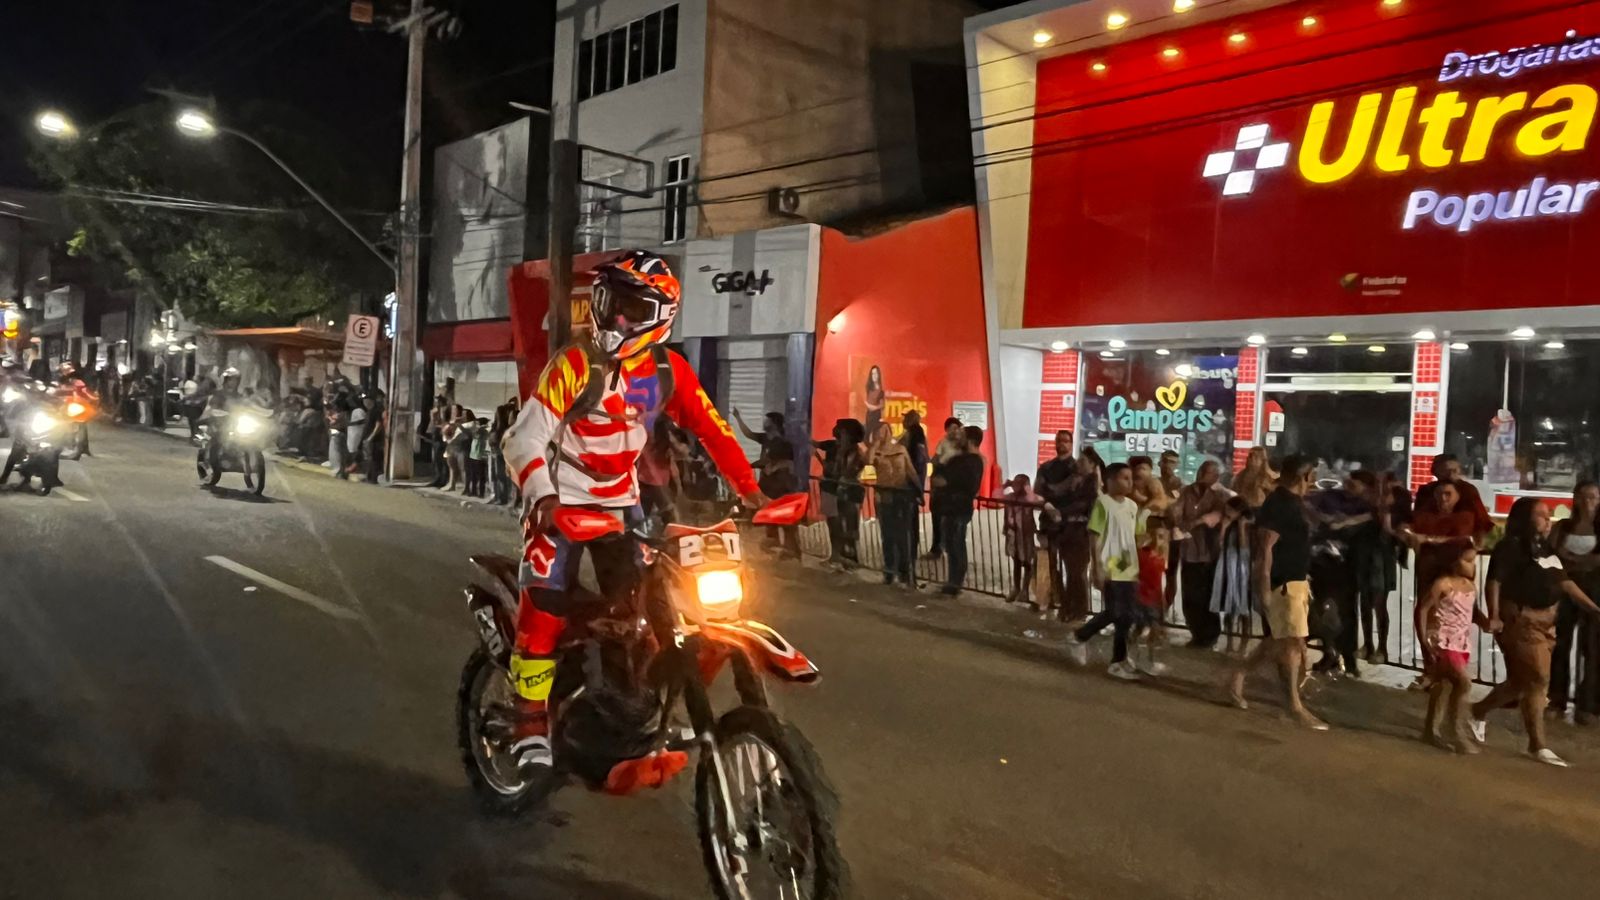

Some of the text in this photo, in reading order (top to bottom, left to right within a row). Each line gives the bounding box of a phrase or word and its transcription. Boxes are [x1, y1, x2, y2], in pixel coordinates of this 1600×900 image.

[1298, 84, 1598, 184] Ultra
[1402, 177, 1600, 232] Popular
[1108, 395, 1213, 434] Pampers
